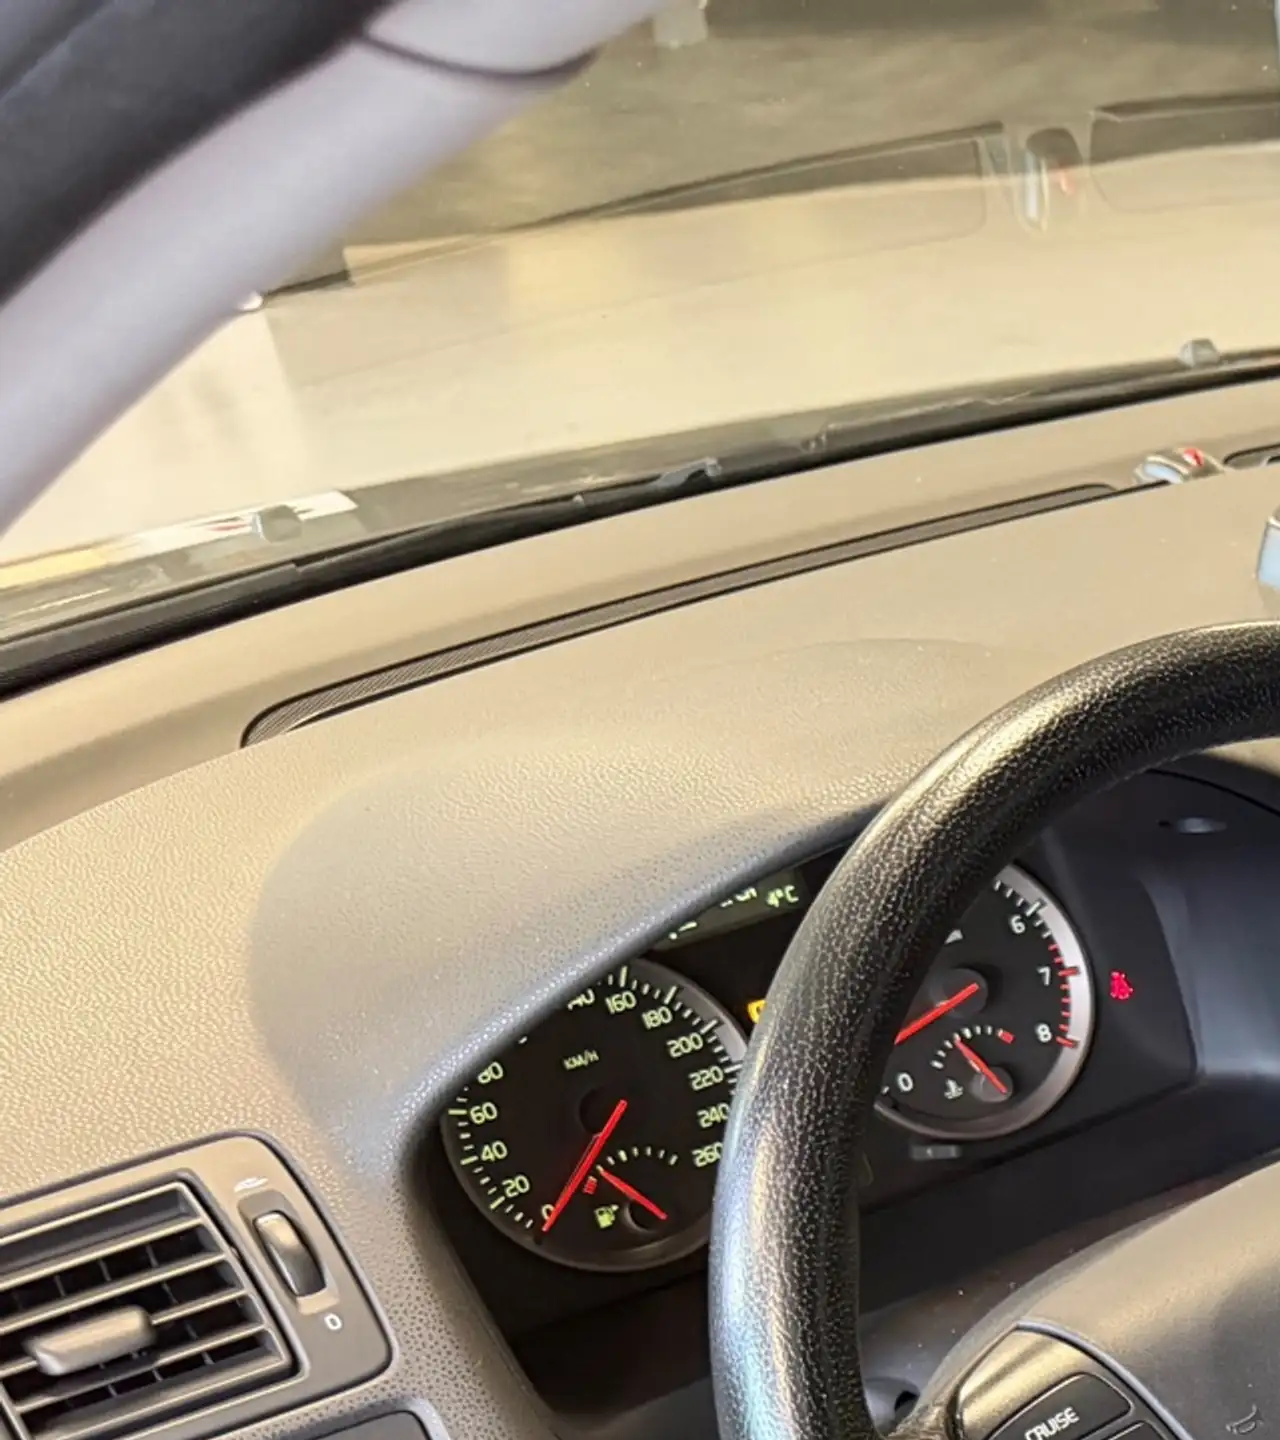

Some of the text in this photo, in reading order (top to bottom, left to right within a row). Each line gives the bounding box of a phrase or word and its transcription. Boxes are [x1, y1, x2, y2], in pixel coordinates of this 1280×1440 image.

[1010, 914, 1027, 935] 6
[1036, 965, 1052, 986] 7
[604, 990, 637, 1015] 160
[641, 1005, 673, 1030] 180
[1035, 1023, 1053, 1043] 8
[666, 1032, 704, 1059] 200
[563, 1049, 600, 1070] KM/H
[688, 1065, 725, 1091] 220
[897, 1072, 914, 1093] 0
[469, 1101, 498, 1125] 60
[696, 1102, 731, 1128] 240
[480, 1140, 508, 1162] 40
[501, 1174, 530, 1198] 20
[323, 1312, 343, 1331] 0
